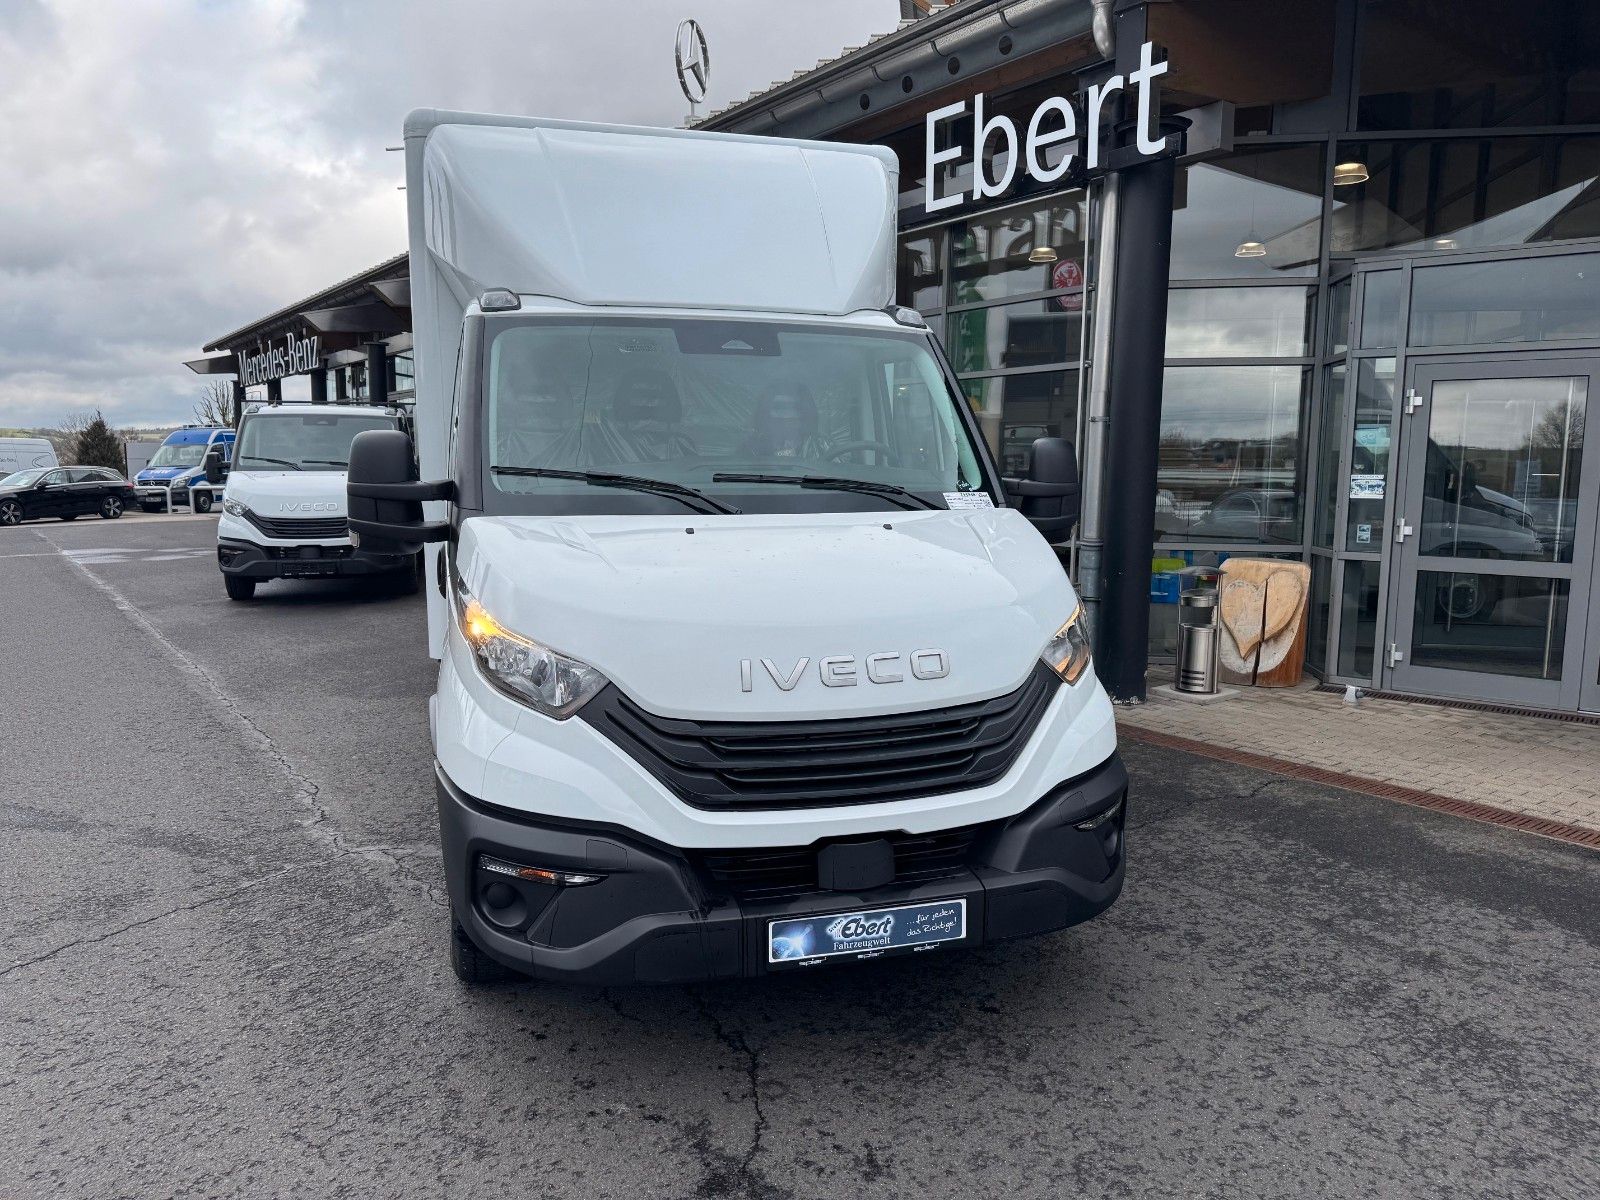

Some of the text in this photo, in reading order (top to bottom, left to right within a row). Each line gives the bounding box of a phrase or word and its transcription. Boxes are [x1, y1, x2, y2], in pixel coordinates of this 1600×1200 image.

[925, 41, 1168, 213] Ebert
[237, 332, 319, 388] Mercedes-Benz
[280, 502, 338, 512] IVECO
[740, 648, 950, 693] IVECO
[931, 908, 955, 921] jeden
[841, 917, 892, 939] Ebert
[906, 928, 921, 937] das
[833, 937, 891, 951] Fahrzeugwelt
